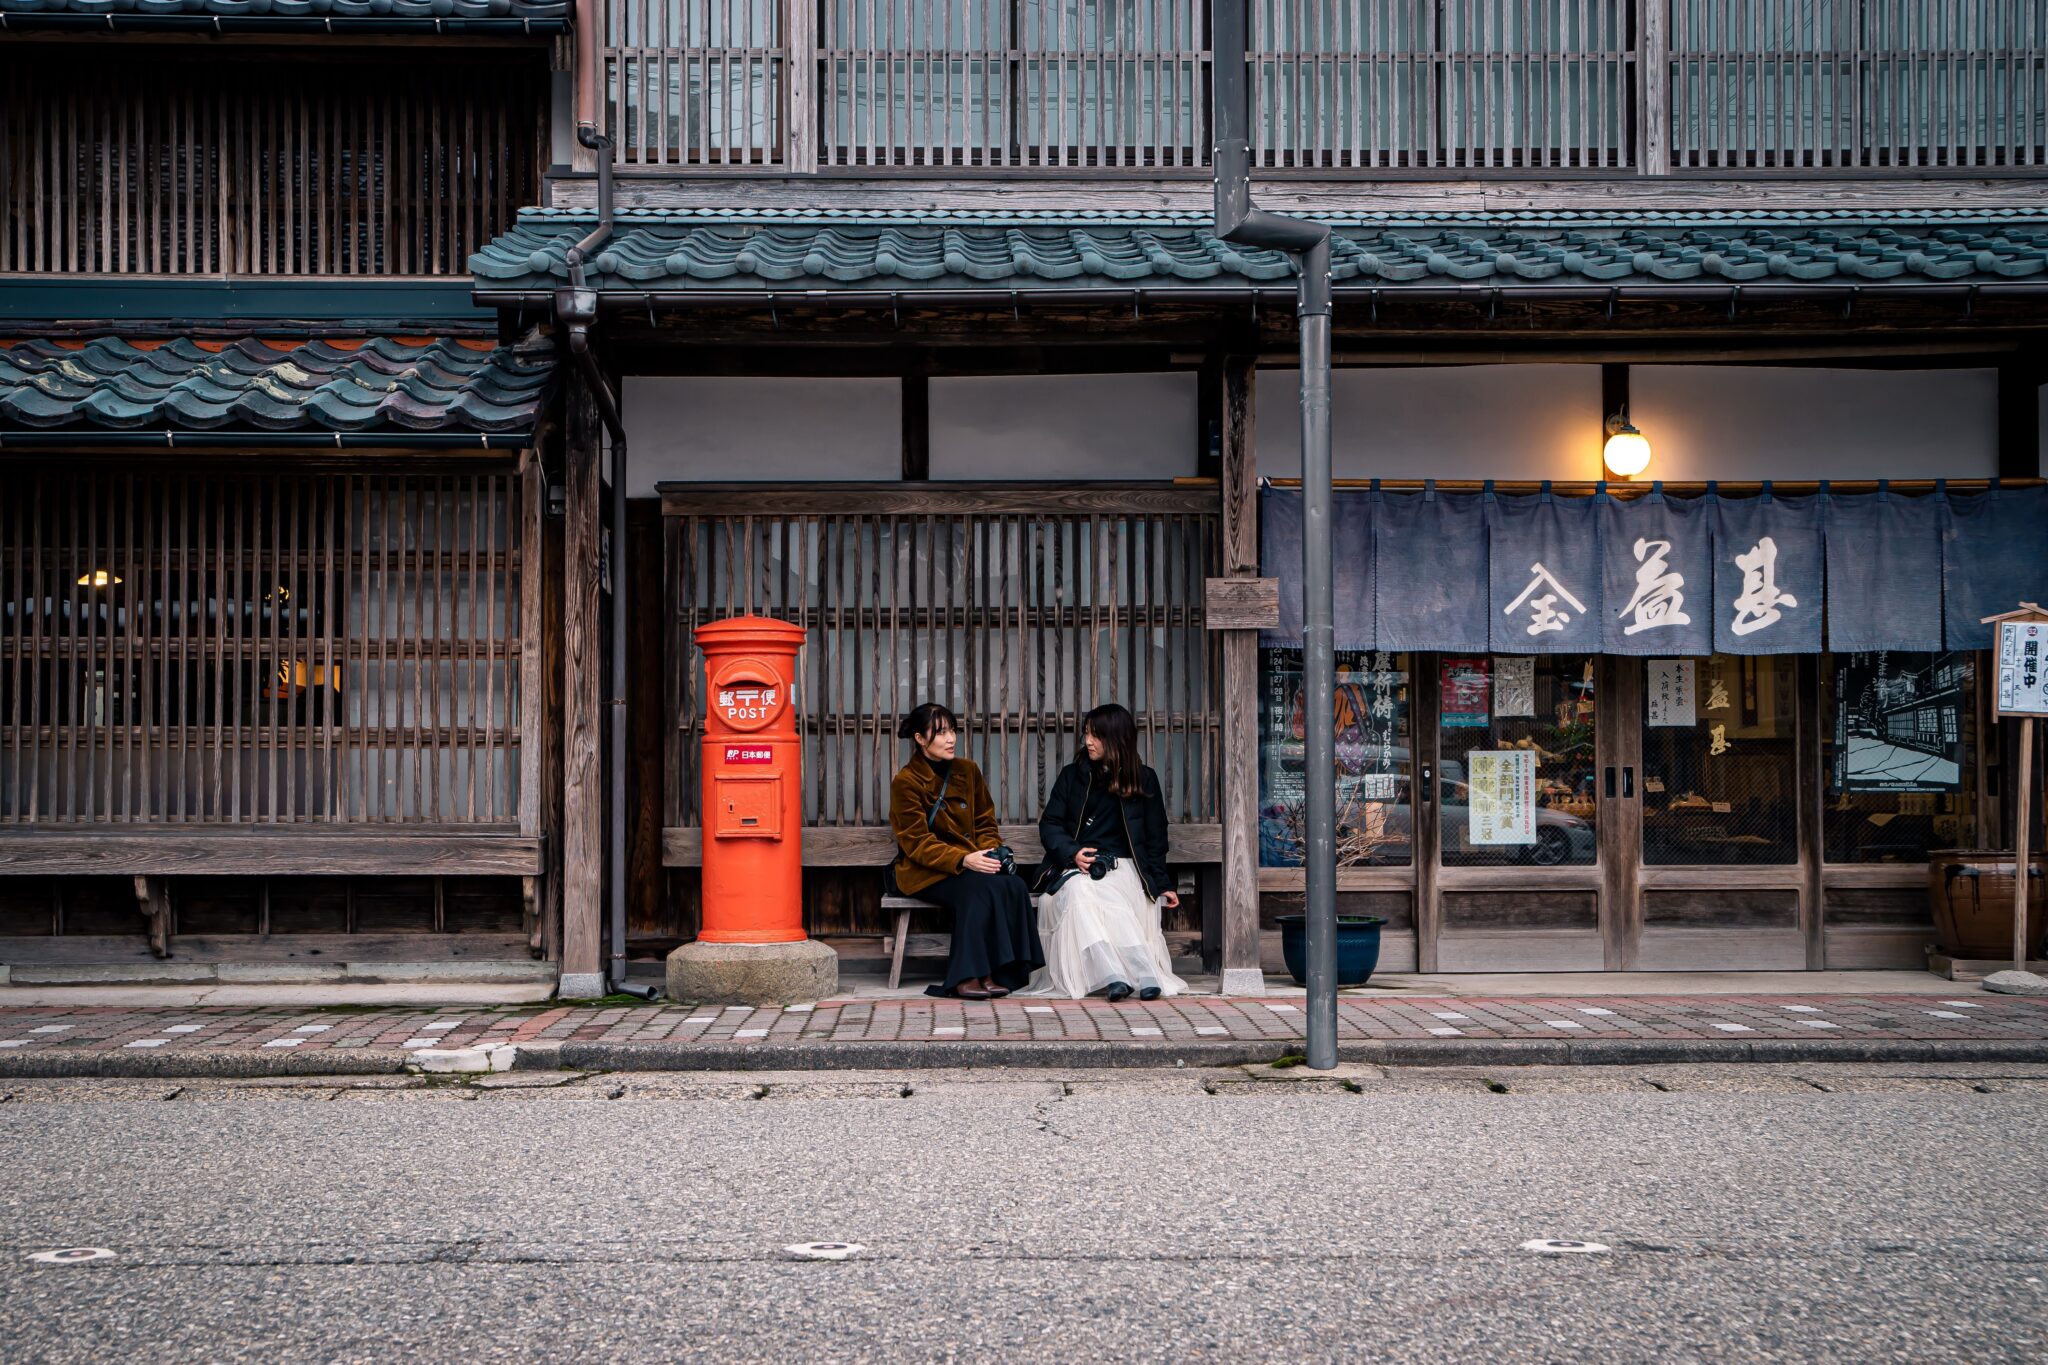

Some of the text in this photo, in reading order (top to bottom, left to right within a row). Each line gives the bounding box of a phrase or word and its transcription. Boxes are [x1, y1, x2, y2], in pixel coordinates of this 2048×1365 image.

[2024, 640, 2038, 688] 開催中
[728, 708, 767, 719] POST
[1274, 706, 1283, 732] 夜7時
[742, 751, 771, 759] 日本郵便
[1382, 729, 1392, 770] むらかみ
[1500, 759, 1514, 829] 全部門受賞
[1481, 815, 1493, 840] 三冠
